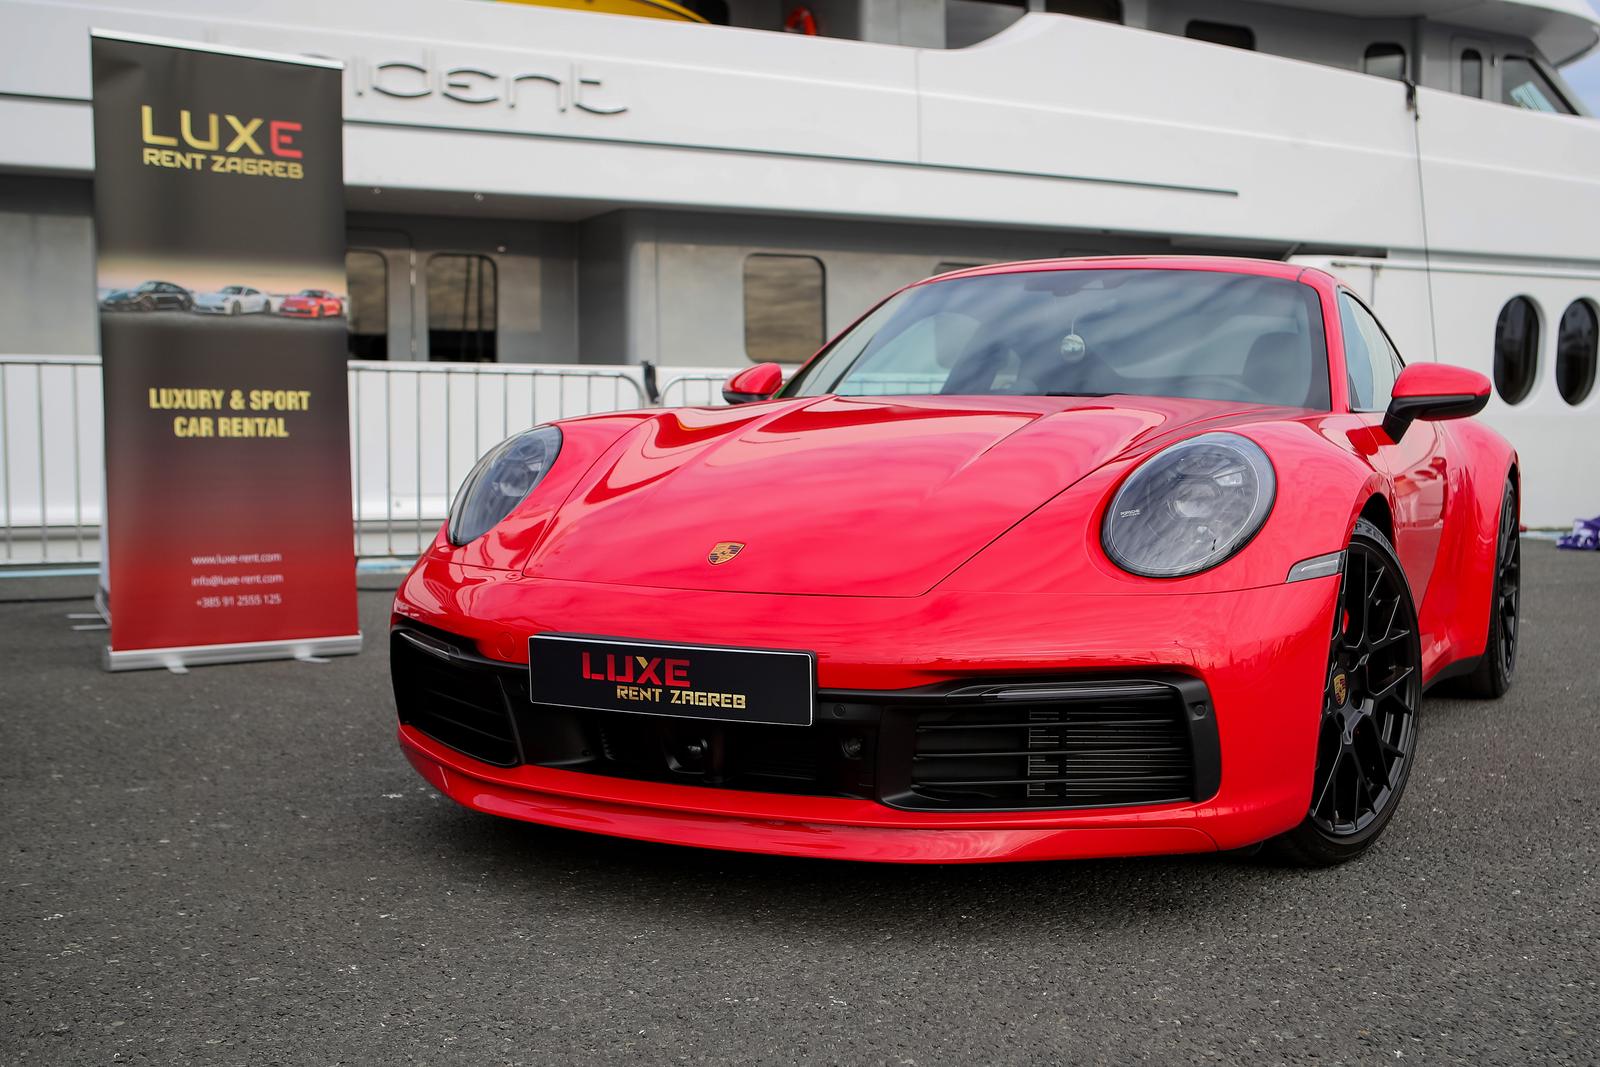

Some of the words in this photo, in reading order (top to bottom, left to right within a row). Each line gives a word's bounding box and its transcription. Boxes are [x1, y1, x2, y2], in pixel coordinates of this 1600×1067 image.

[141, 105, 303, 158] LUXE
[142, 148, 206, 172] RENT
[211, 156, 304, 180] ZAGREB
[149, 388, 225, 410] LUXURY
[229, 389, 246, 410] &
[250, 390, 311, 411] SPORT
[173, 417, 214, 438] CAR
[218, 417, 289, 438] RENTAL
[191, 553, 282, 565] www.luxe-rent.com
[582, 651, 691, 687] LUXE
[616, 685, 663, 702] RENT
[670, 689, 746, 709] ZAGREB
